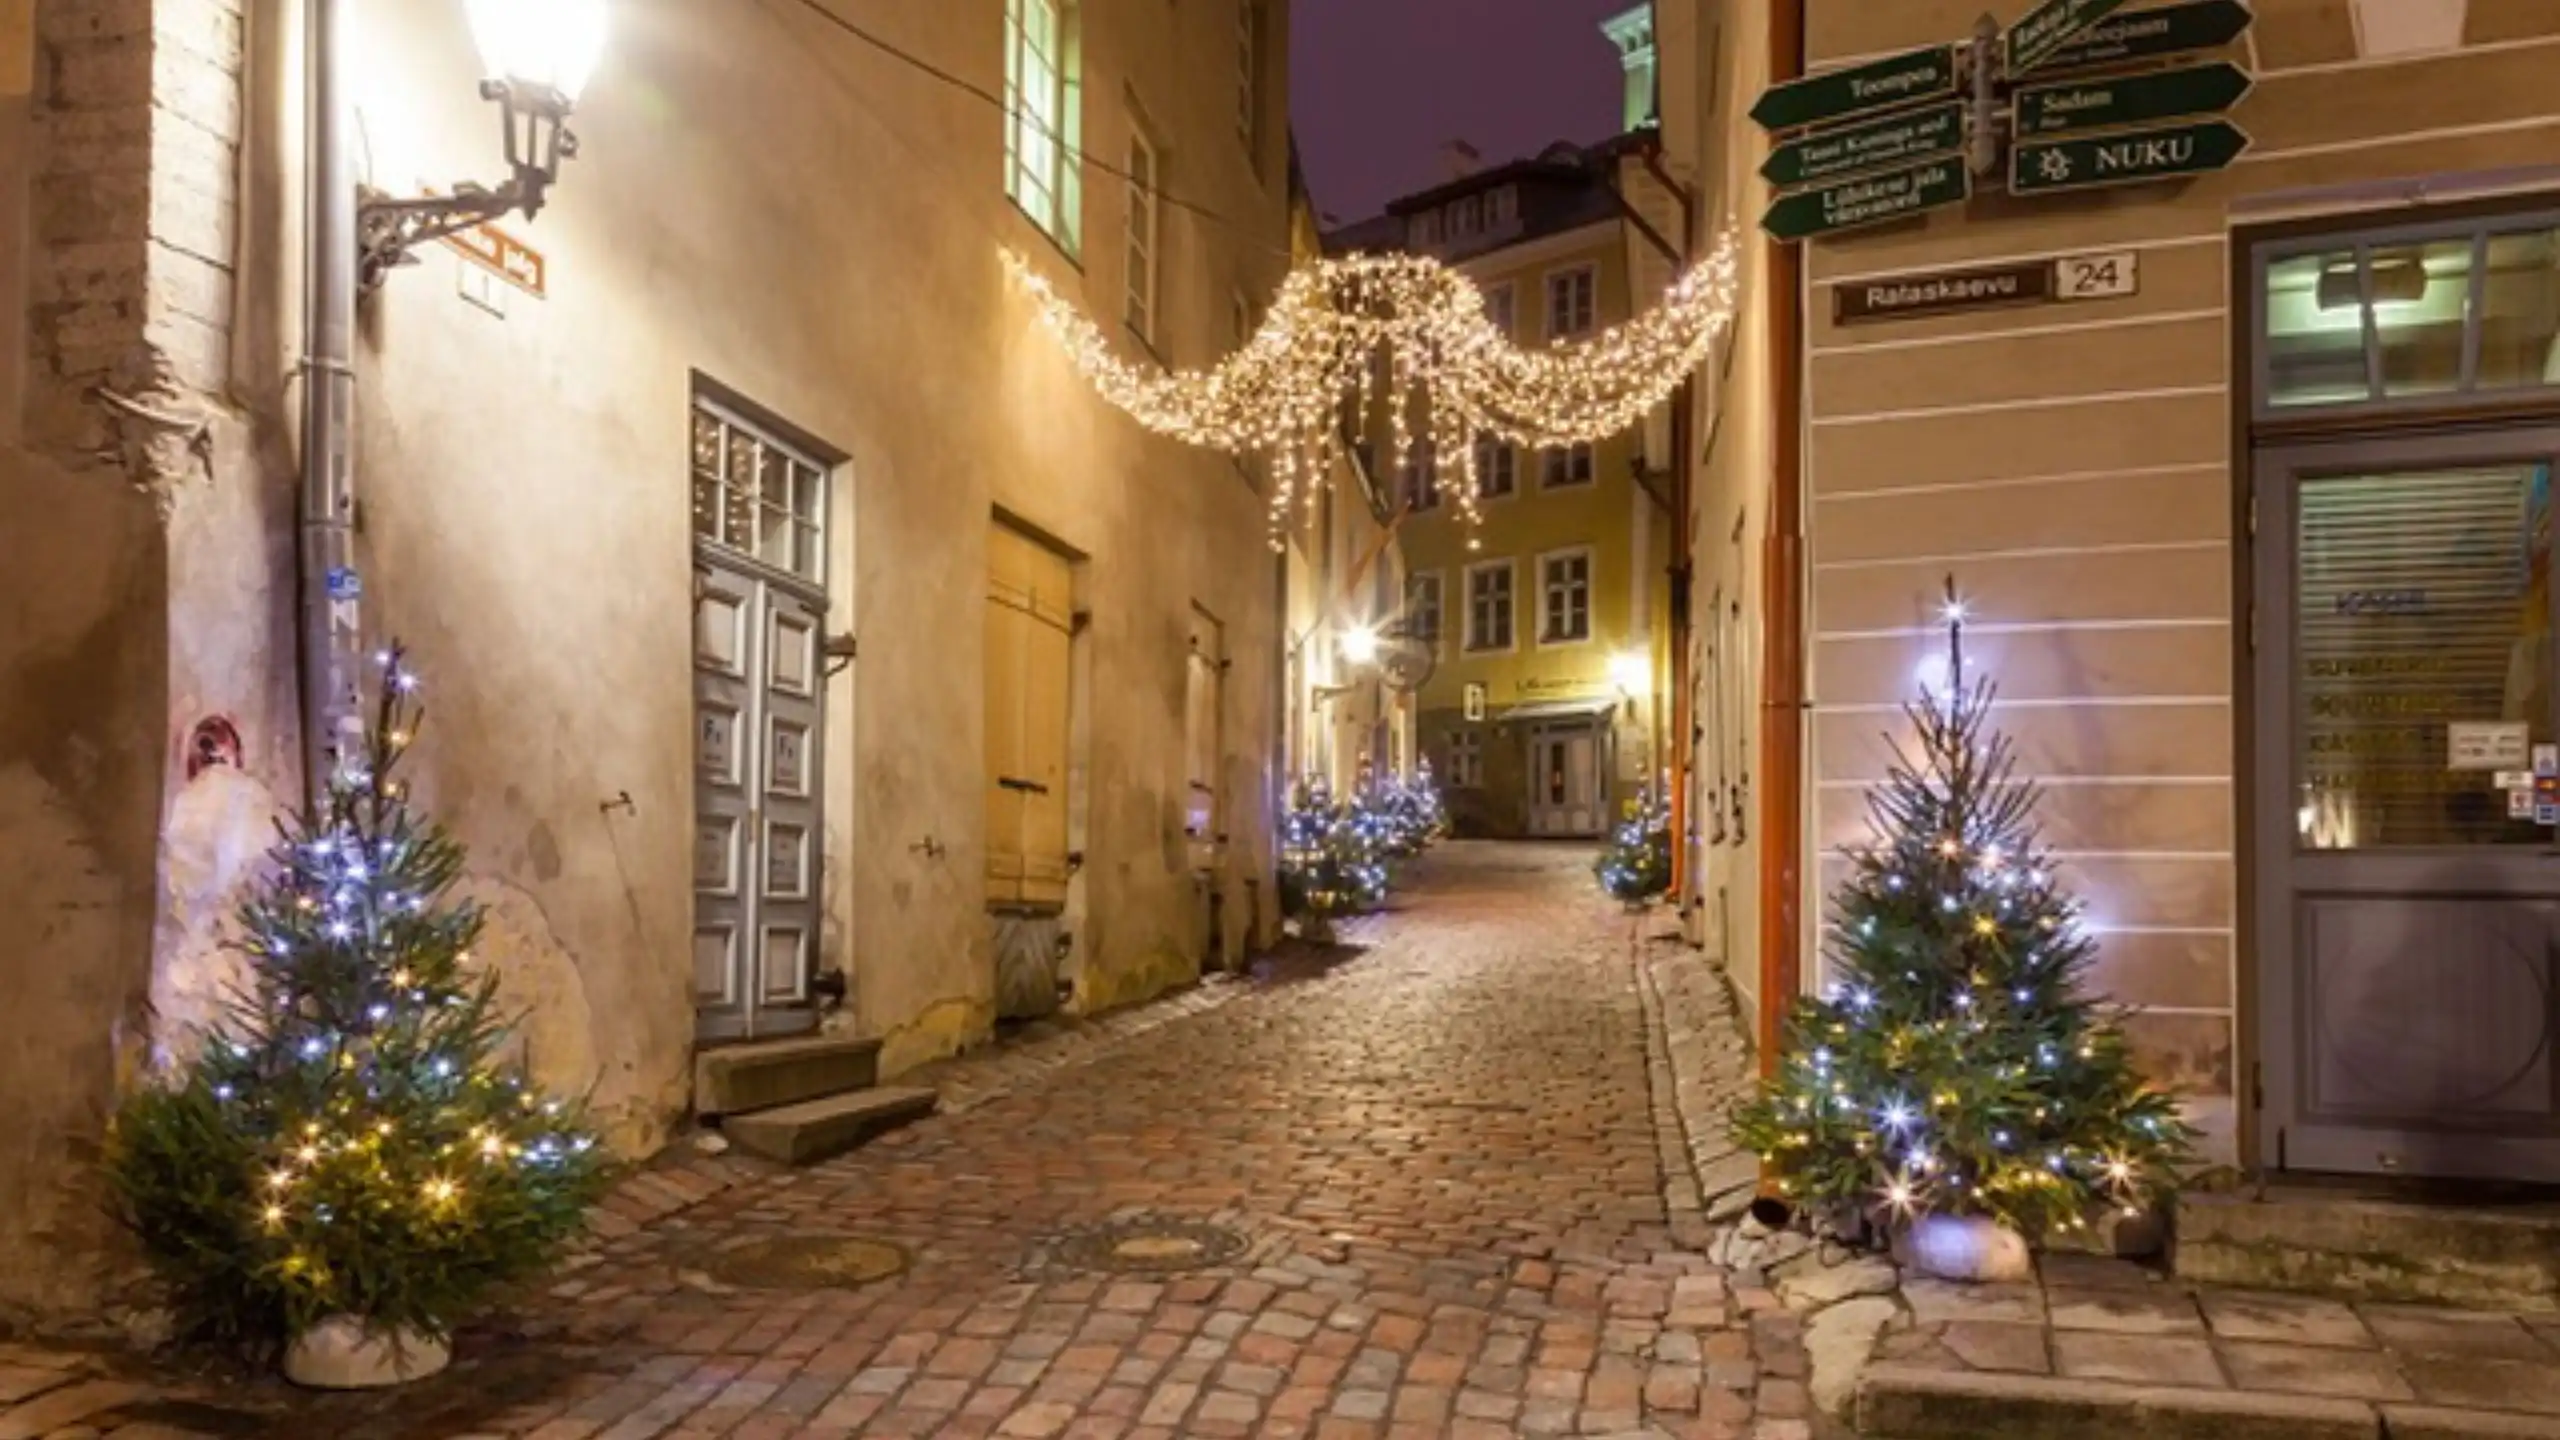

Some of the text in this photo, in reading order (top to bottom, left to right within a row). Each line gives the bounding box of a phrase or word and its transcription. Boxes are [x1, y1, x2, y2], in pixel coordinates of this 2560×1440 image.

[1850, 66, 1938, 97] Toompea
[2043, 90, 2113, 112] Sadam
[2095, 136, 2194, 172] NUKU
[1866, 260, 2119, 309] Rataskaevu 24
